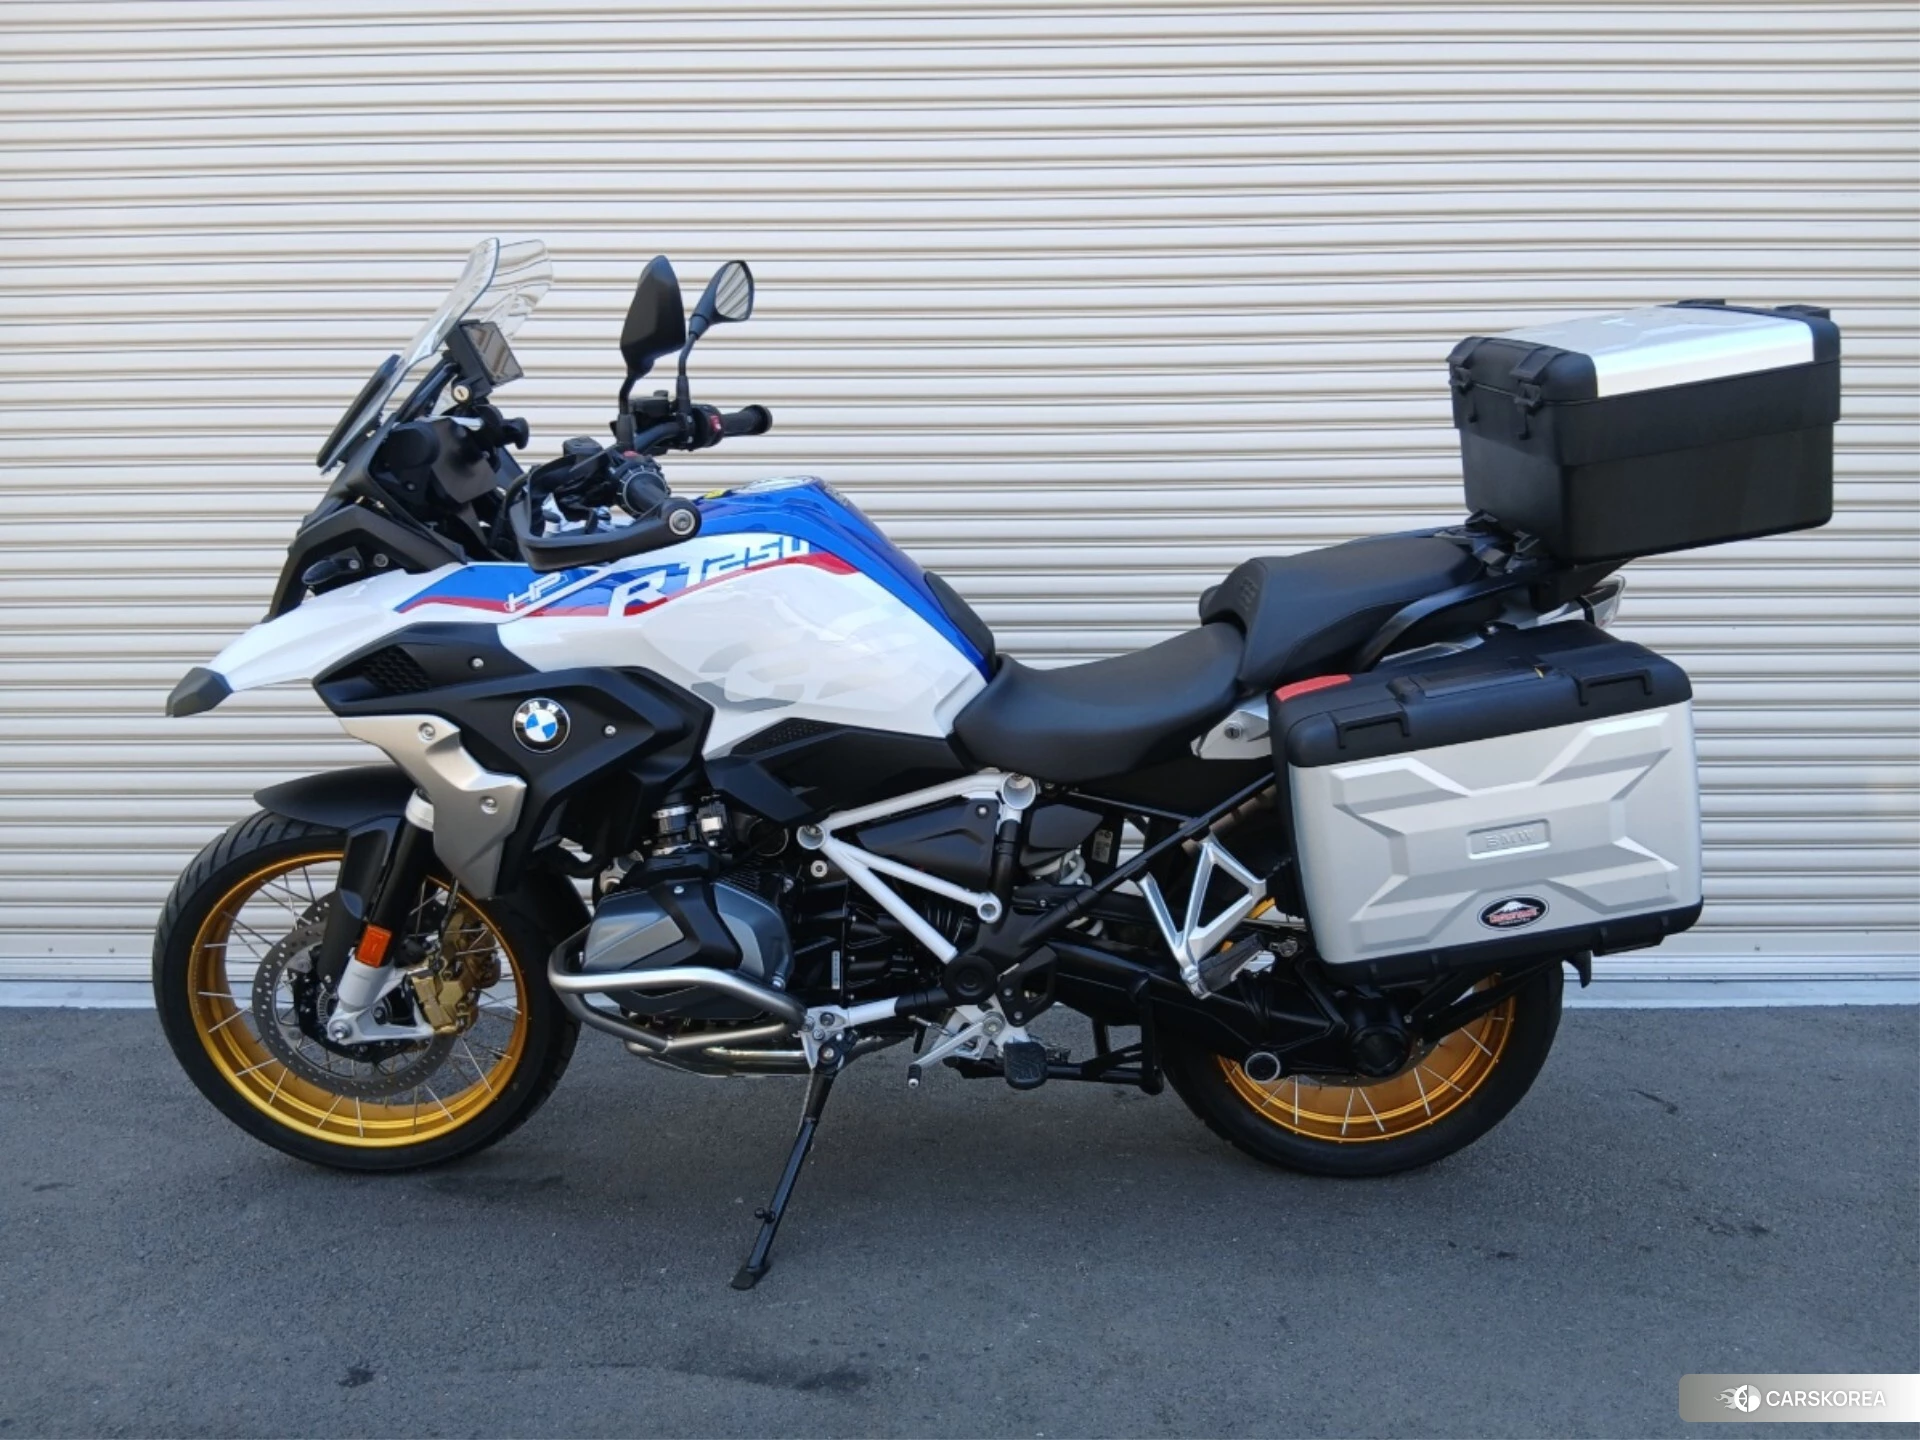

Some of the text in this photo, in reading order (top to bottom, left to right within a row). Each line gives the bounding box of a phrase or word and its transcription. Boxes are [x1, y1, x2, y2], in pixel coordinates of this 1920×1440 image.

[504, 571, 567, 612] HP
[608, 570, 668, 617] R
[516, 701, 560, 724] BMW
[1485, 829, 1536, 850] BMW
